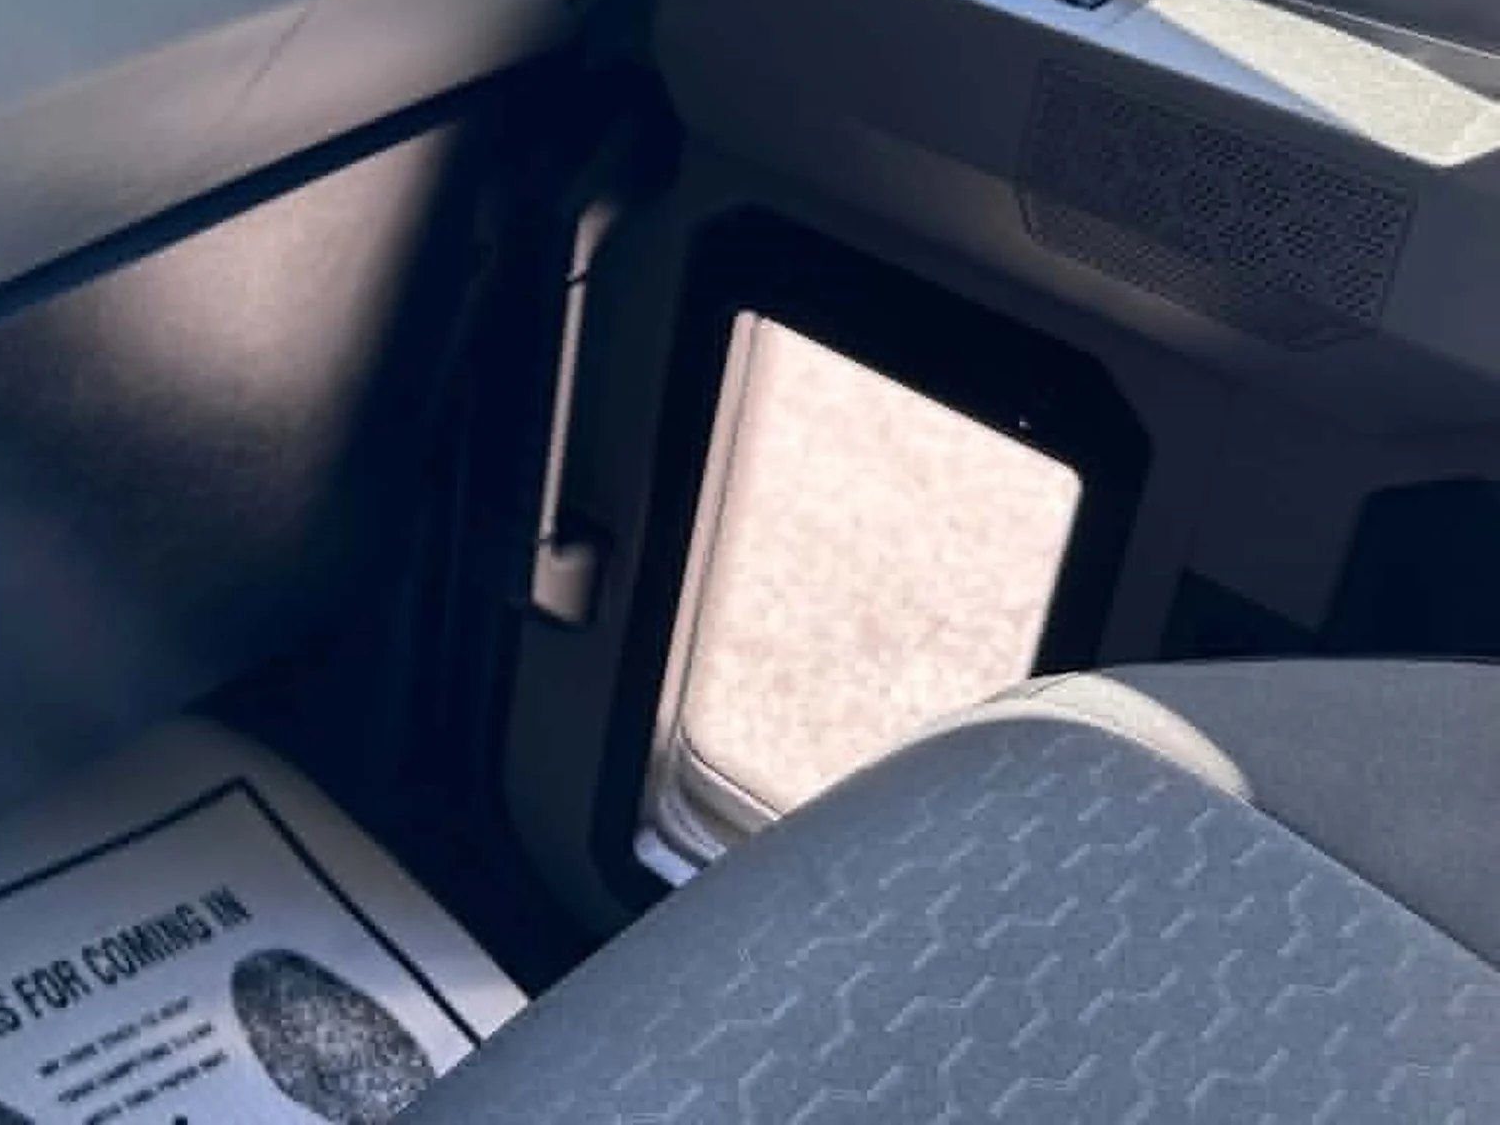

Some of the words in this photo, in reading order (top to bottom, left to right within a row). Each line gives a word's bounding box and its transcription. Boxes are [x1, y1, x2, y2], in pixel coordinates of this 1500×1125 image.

[11, 960, 94, 1019] FOR
[80, 902, 214, 988] COMING
[199, 884, 253, 929] IN
